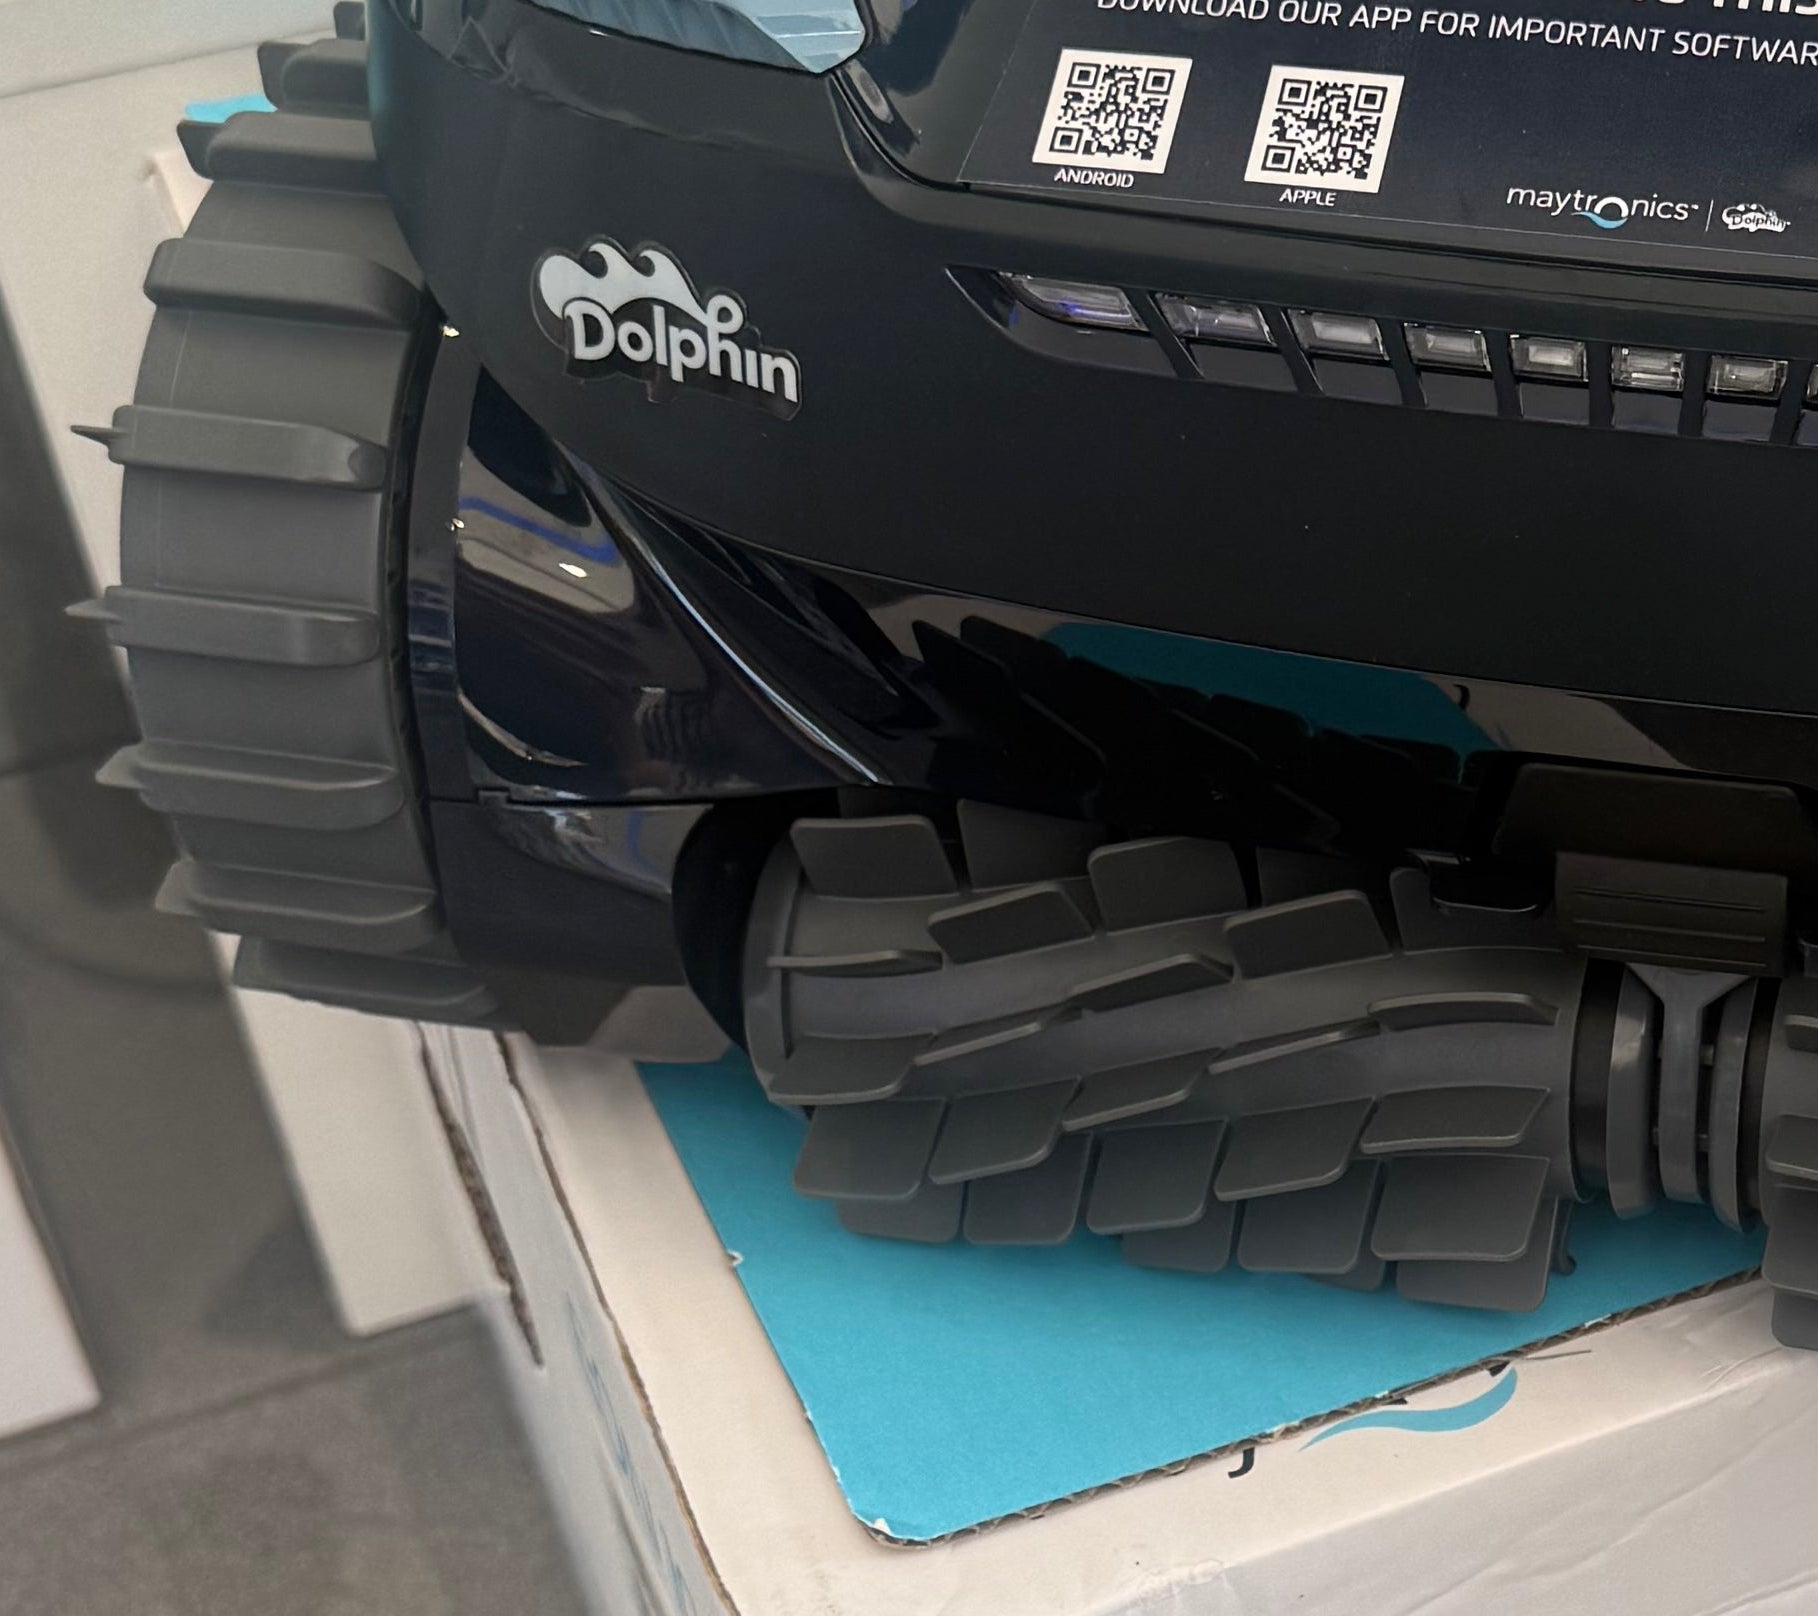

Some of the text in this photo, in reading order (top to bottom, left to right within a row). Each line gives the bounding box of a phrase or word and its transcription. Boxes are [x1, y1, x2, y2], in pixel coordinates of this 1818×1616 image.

[1278, 0, 1342, 26] OUR
[1349, 5, 1412, 32] APP
[1419, 10, 1478, 37] FOR
[1488, 15, 1663, 56] IMPORTANT
[1054, 167, 1134, 188] ANDROID
[1279, 188, 1337, 207] APPLE
[564, 292, 798, 403] Dolphin
